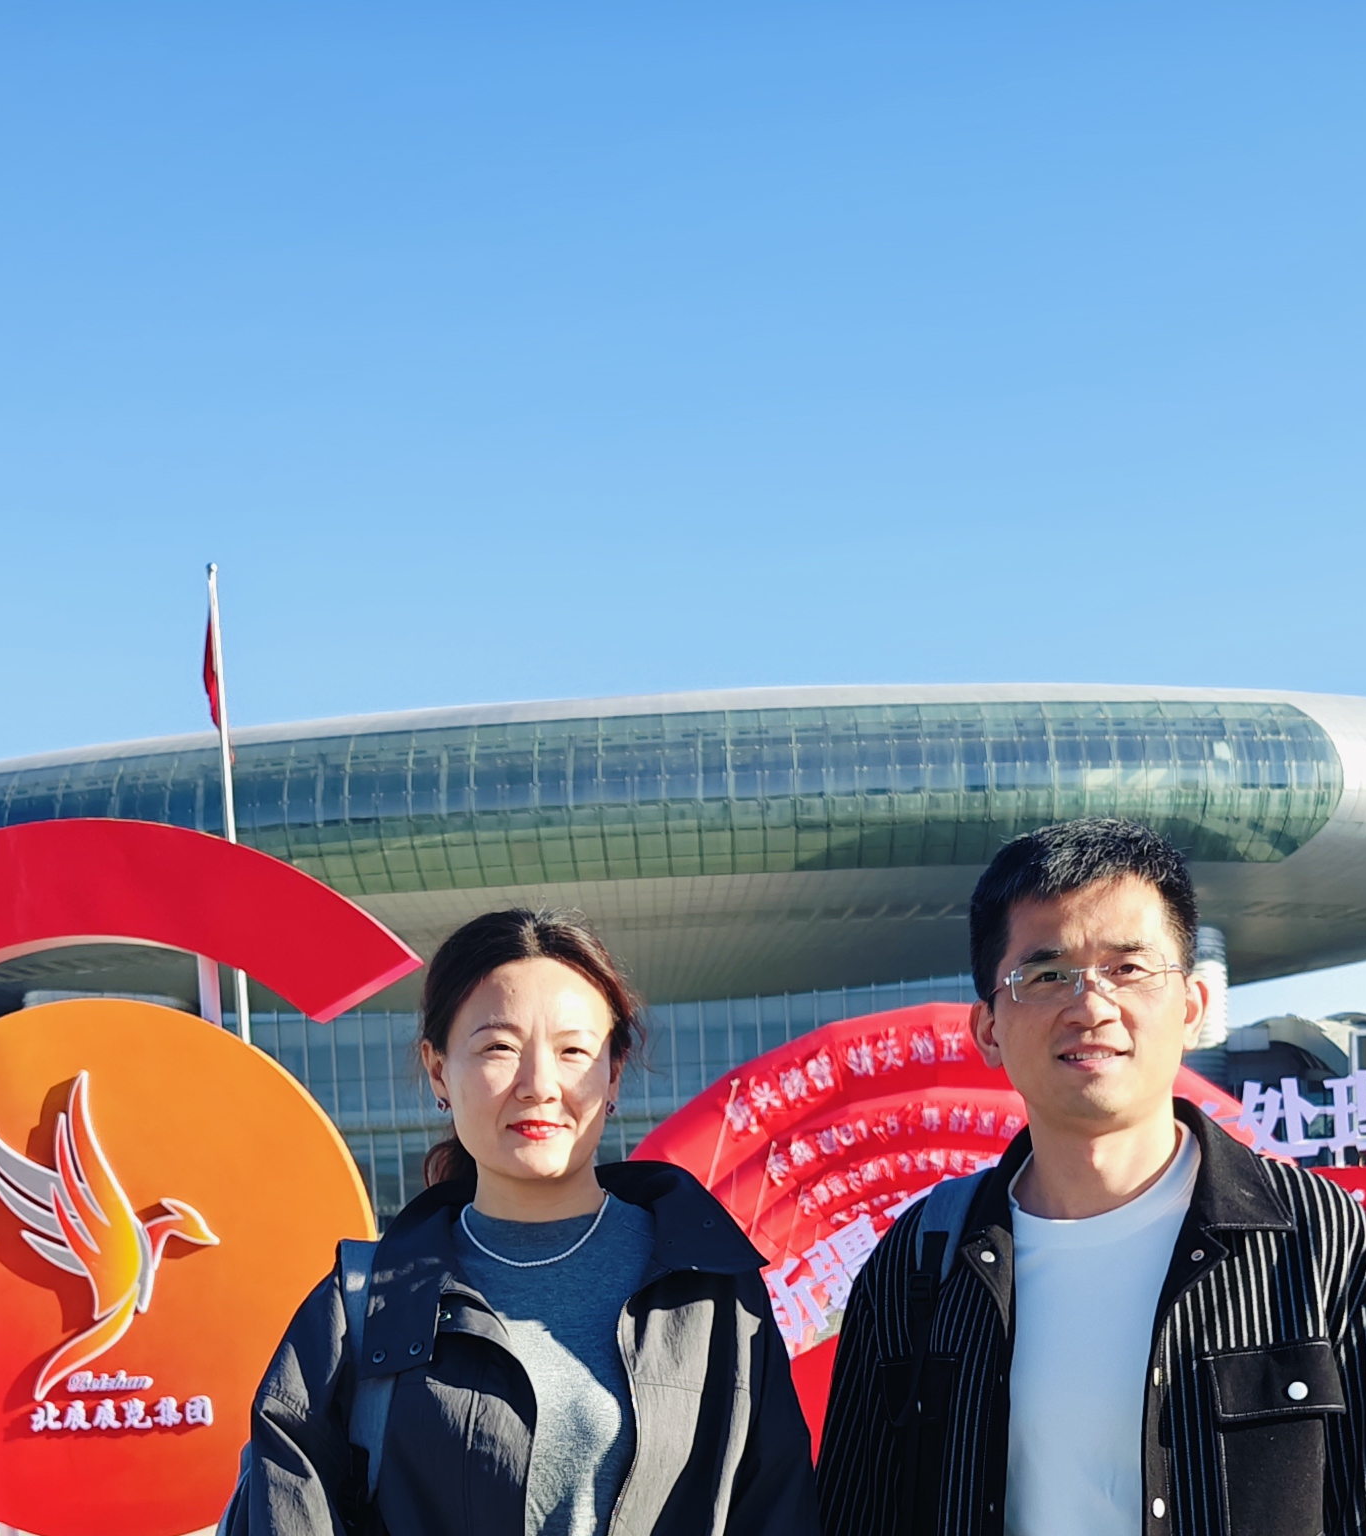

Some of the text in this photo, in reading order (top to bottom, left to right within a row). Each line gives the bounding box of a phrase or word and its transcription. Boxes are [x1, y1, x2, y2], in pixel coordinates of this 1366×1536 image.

[29, 1394, 214, 1433] 北展展览集团
